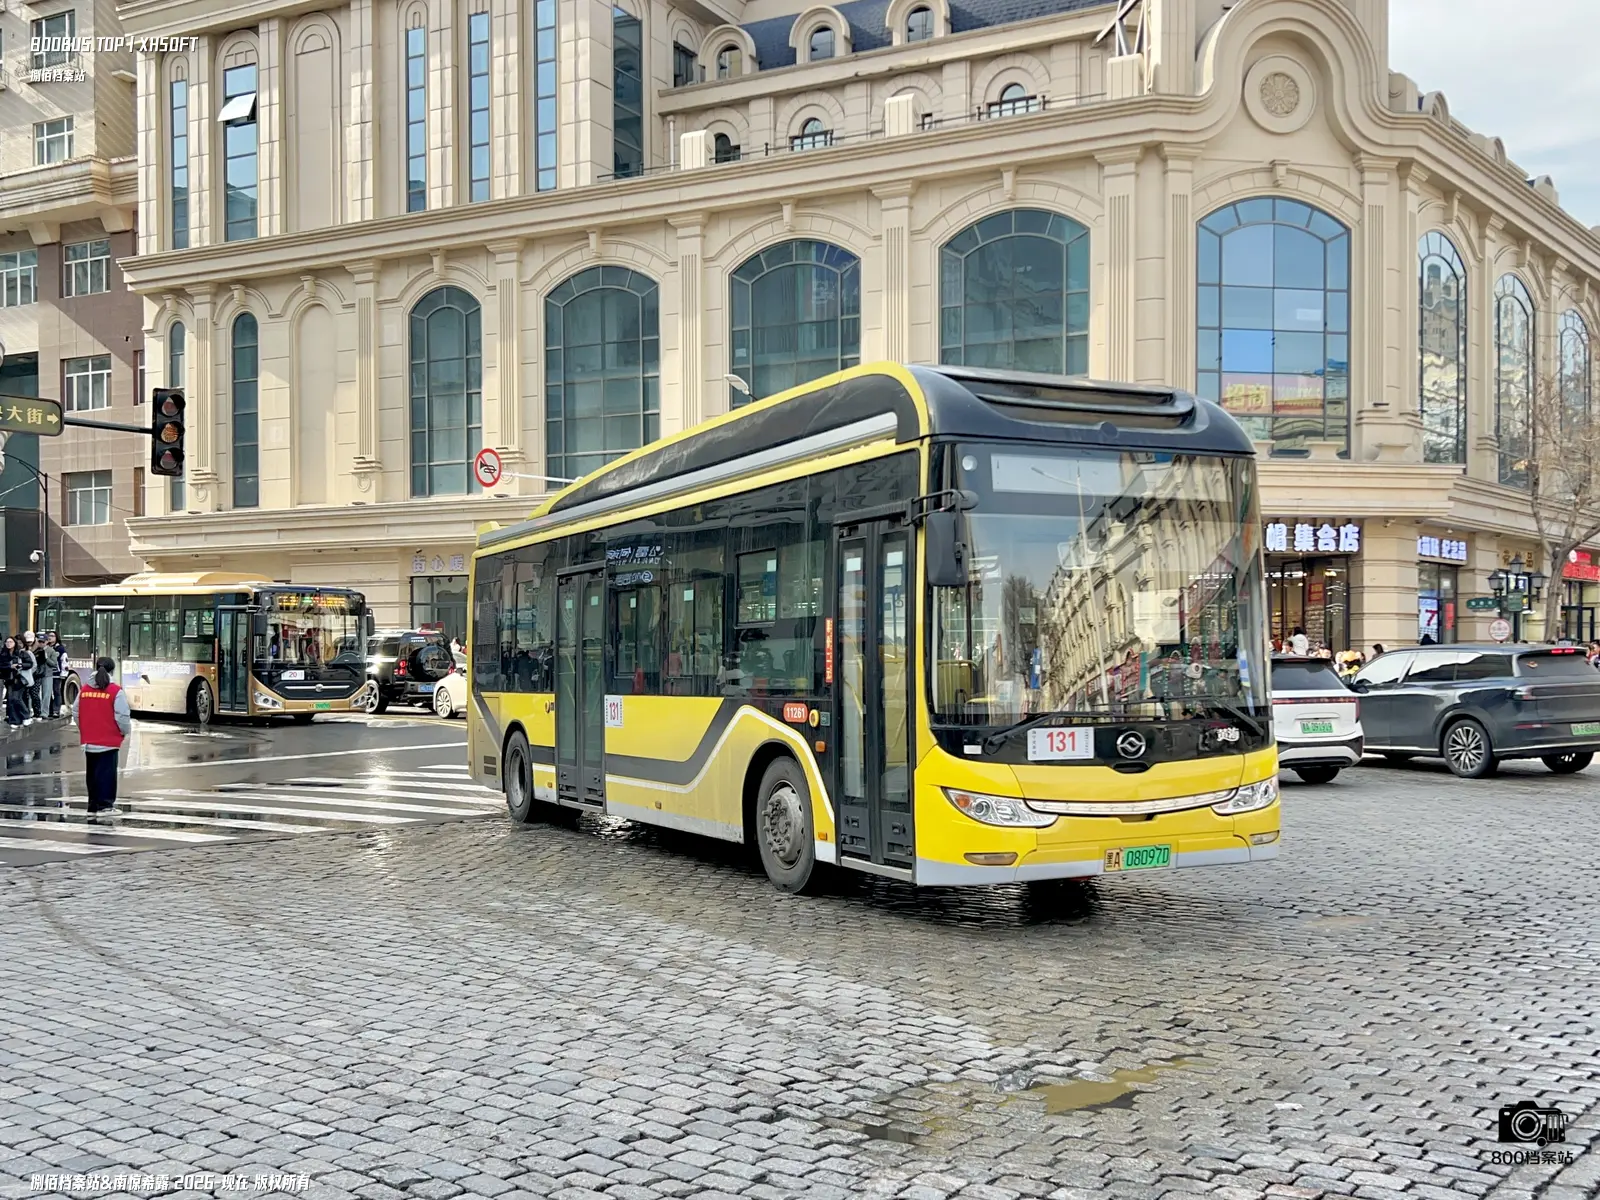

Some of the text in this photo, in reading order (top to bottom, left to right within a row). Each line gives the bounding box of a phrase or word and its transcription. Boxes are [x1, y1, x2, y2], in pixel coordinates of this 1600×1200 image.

[1293, 522, 1360, 552] 集合店
[609, 702, 619, 721] 131
[786, 707, 805, 719] 11261
[1046, 731, 1076, 752] 131
